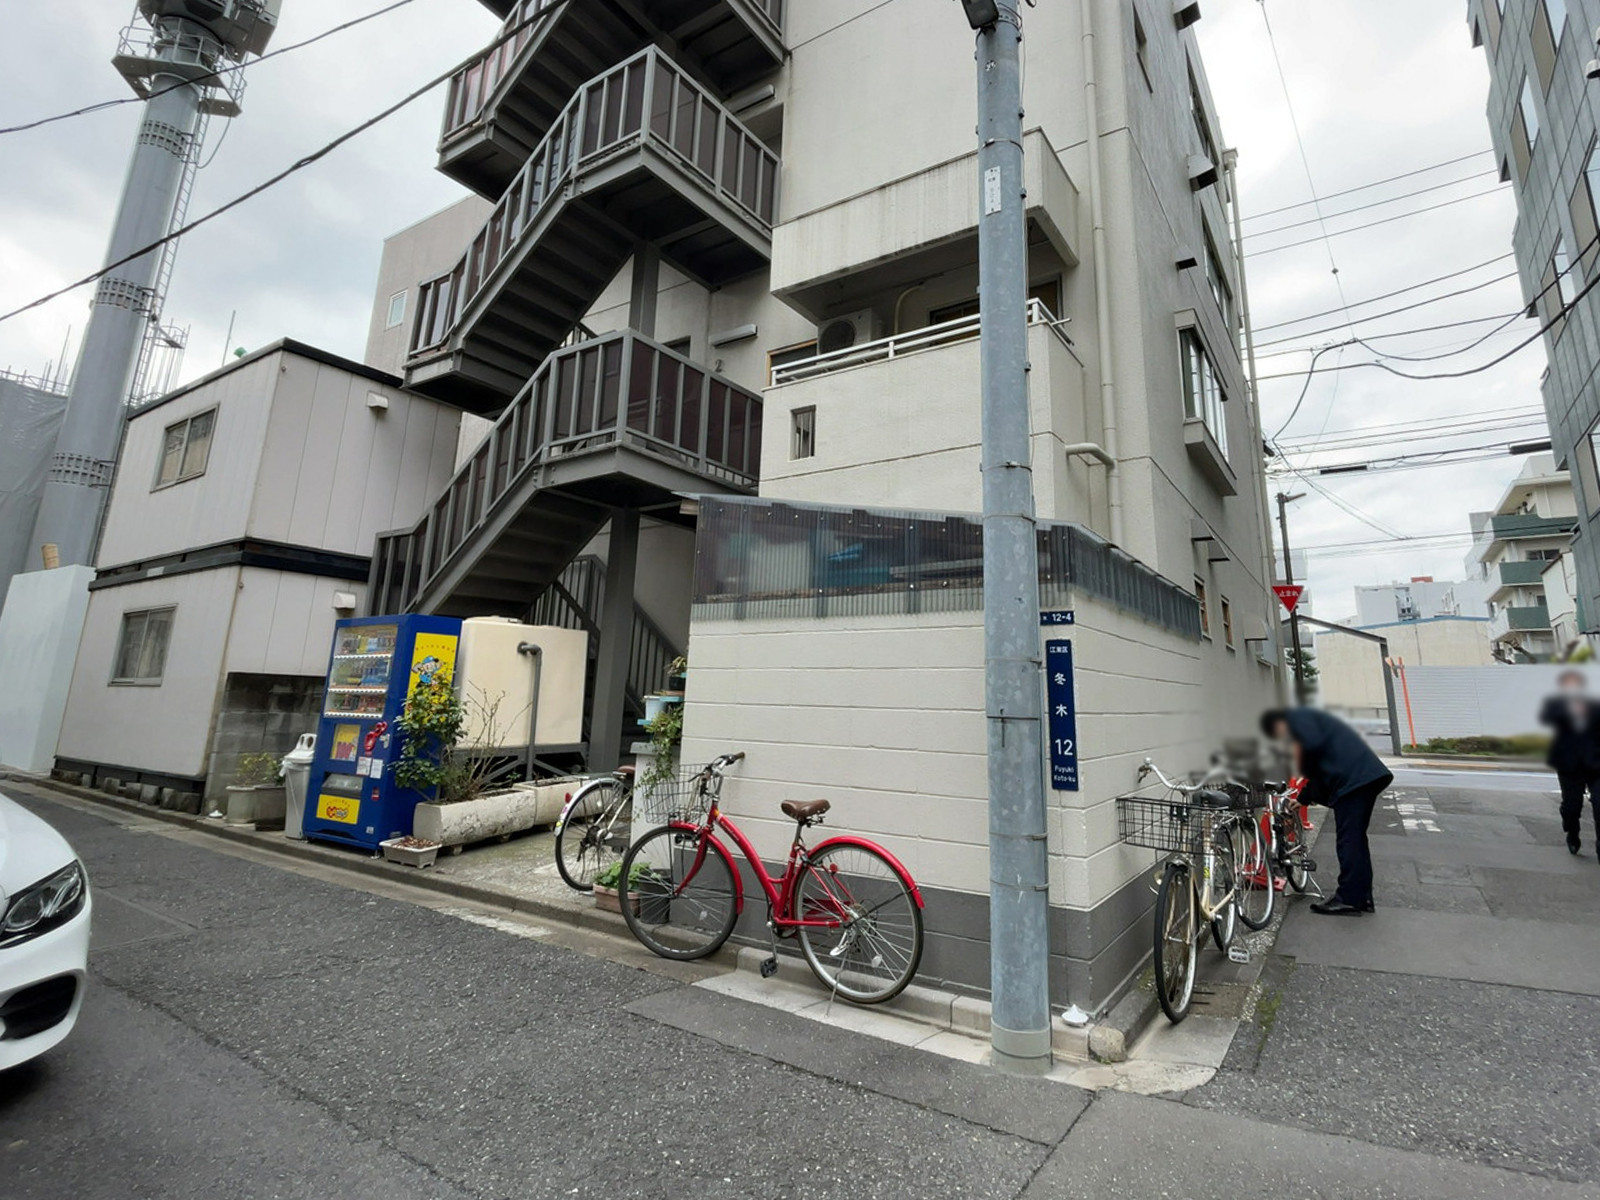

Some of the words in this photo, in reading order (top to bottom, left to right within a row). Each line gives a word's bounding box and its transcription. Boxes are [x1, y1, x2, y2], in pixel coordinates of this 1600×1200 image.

[1052, 613, 1072, 622] 12-4
[1054, 672, 1068, 717] 冬木
[1055, 739, 1074, 756] 12
